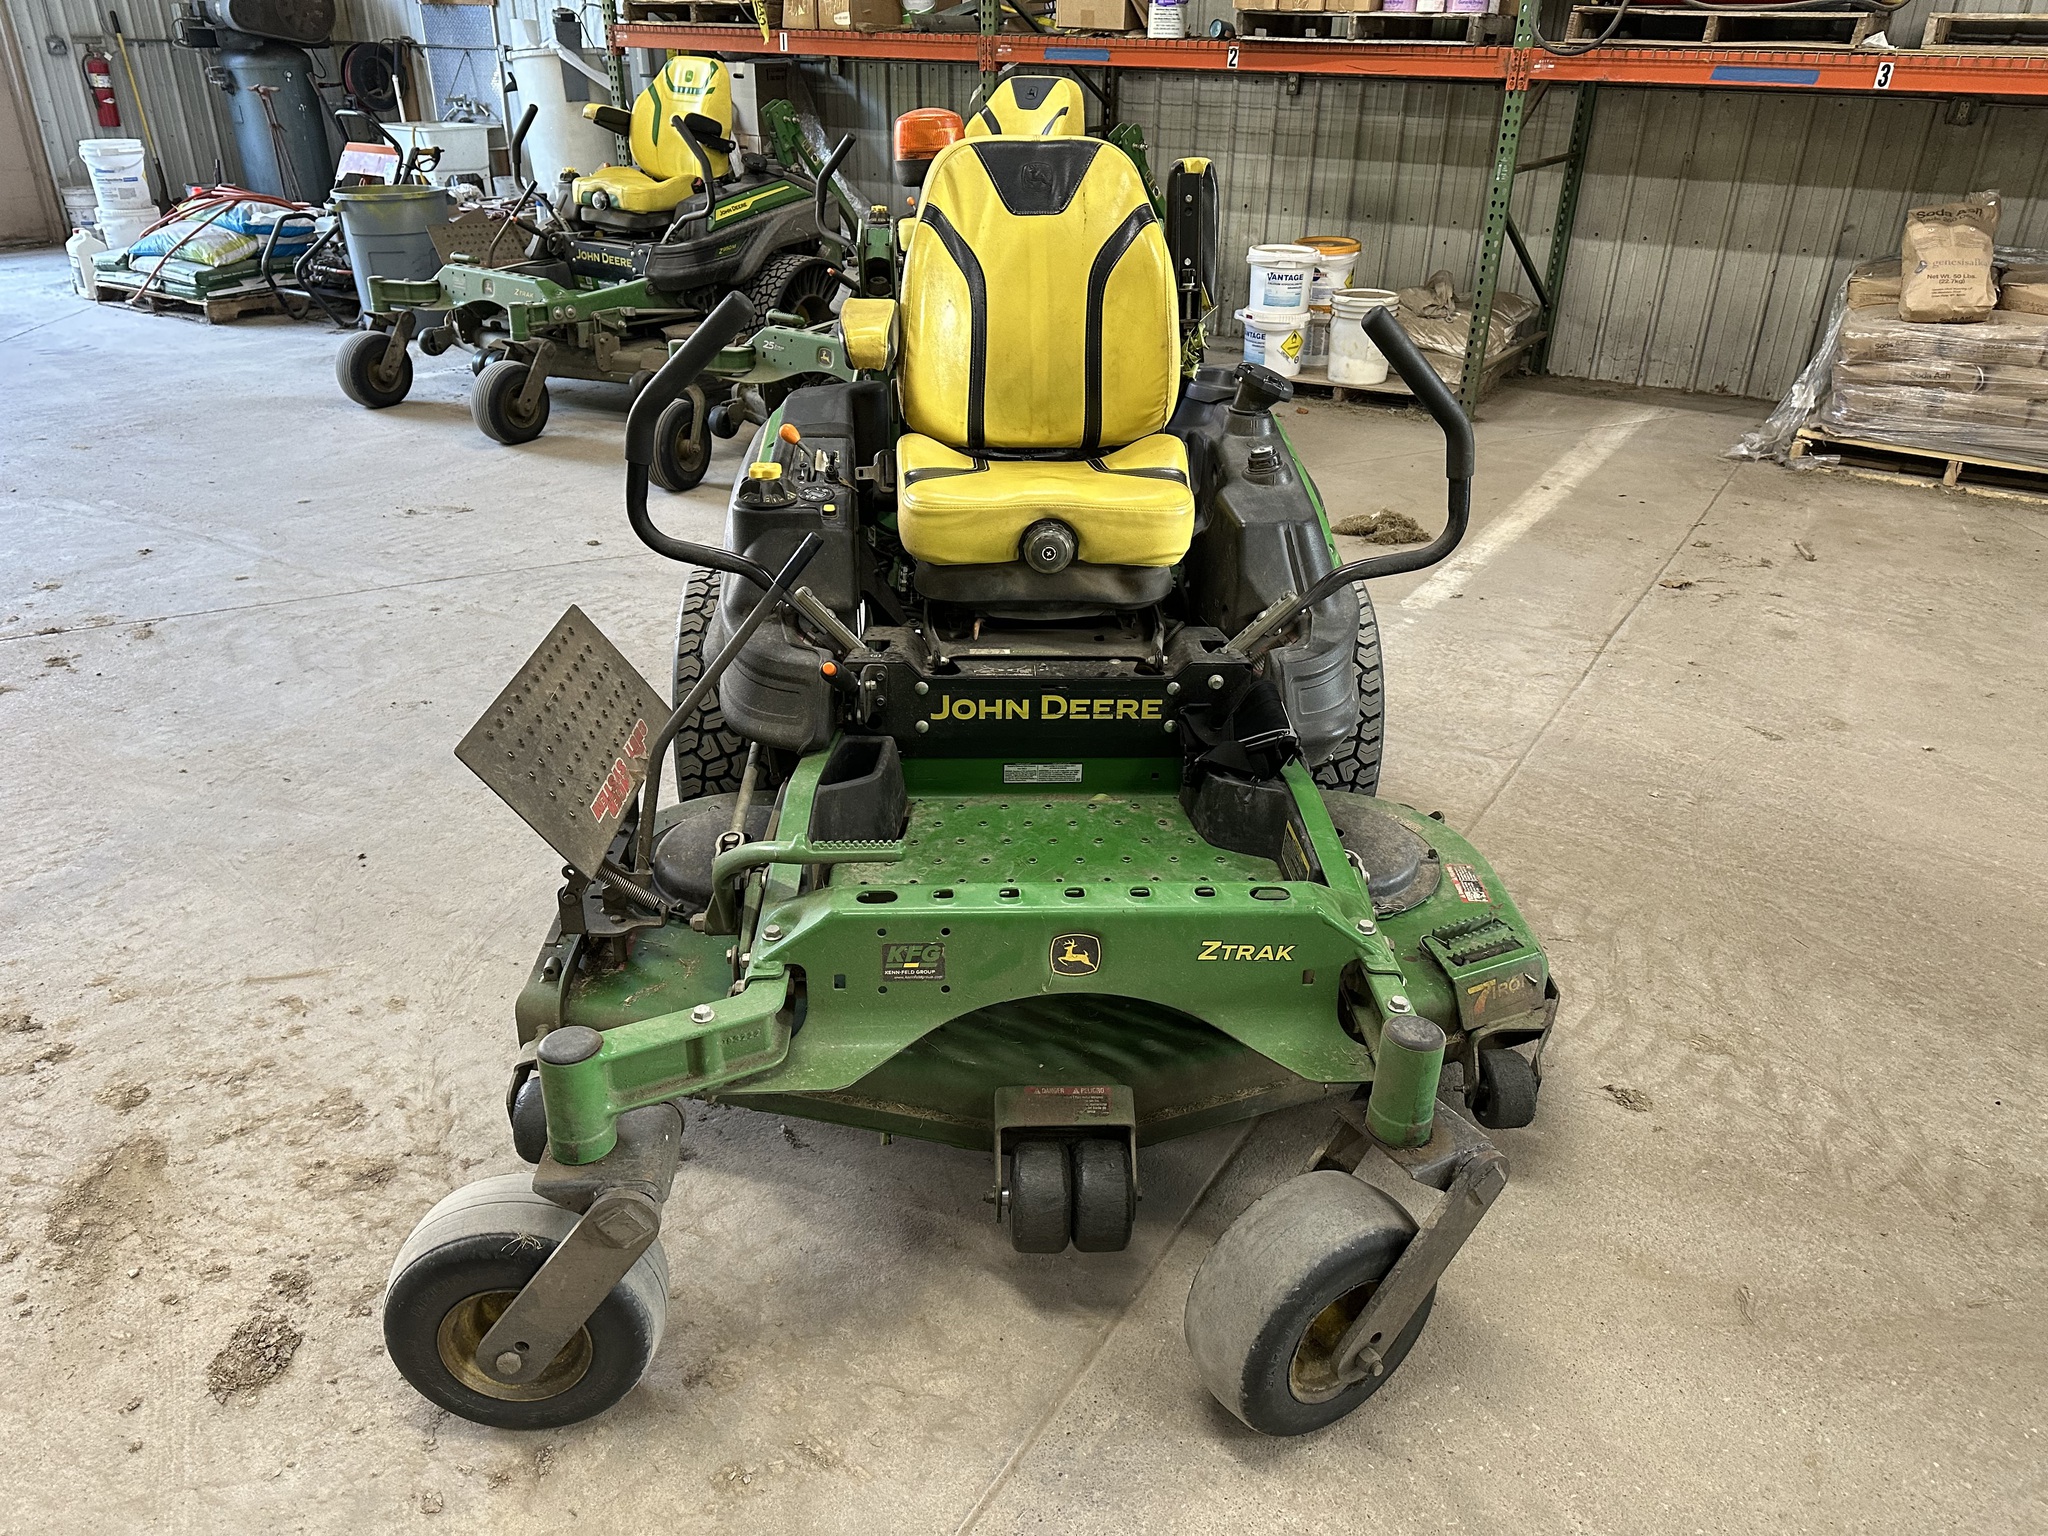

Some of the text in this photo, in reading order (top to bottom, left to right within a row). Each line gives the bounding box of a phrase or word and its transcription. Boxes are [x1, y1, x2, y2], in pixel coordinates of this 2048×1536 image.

[1228, 47, 1238, 67] 2
[1877, 63, 1891, 88] 3
[731, 202, 747, 211] DEERE
[1916, 208, 1953, 219] Soda
[576, 249, 633, 268] JOHN DEERE
[1267, 272, 1304, 281] VANTAGE
[1246, 331, 1266, 341] NTAGE
[762, 340, 776, 349] 25
[1933, 371, 1951, 379] Ash
[930, 694, 1164, 721] JOHN DEERE
[886, 945, 942, 962] KFG
[1197, 940, 1297, 961] ZTRAK
